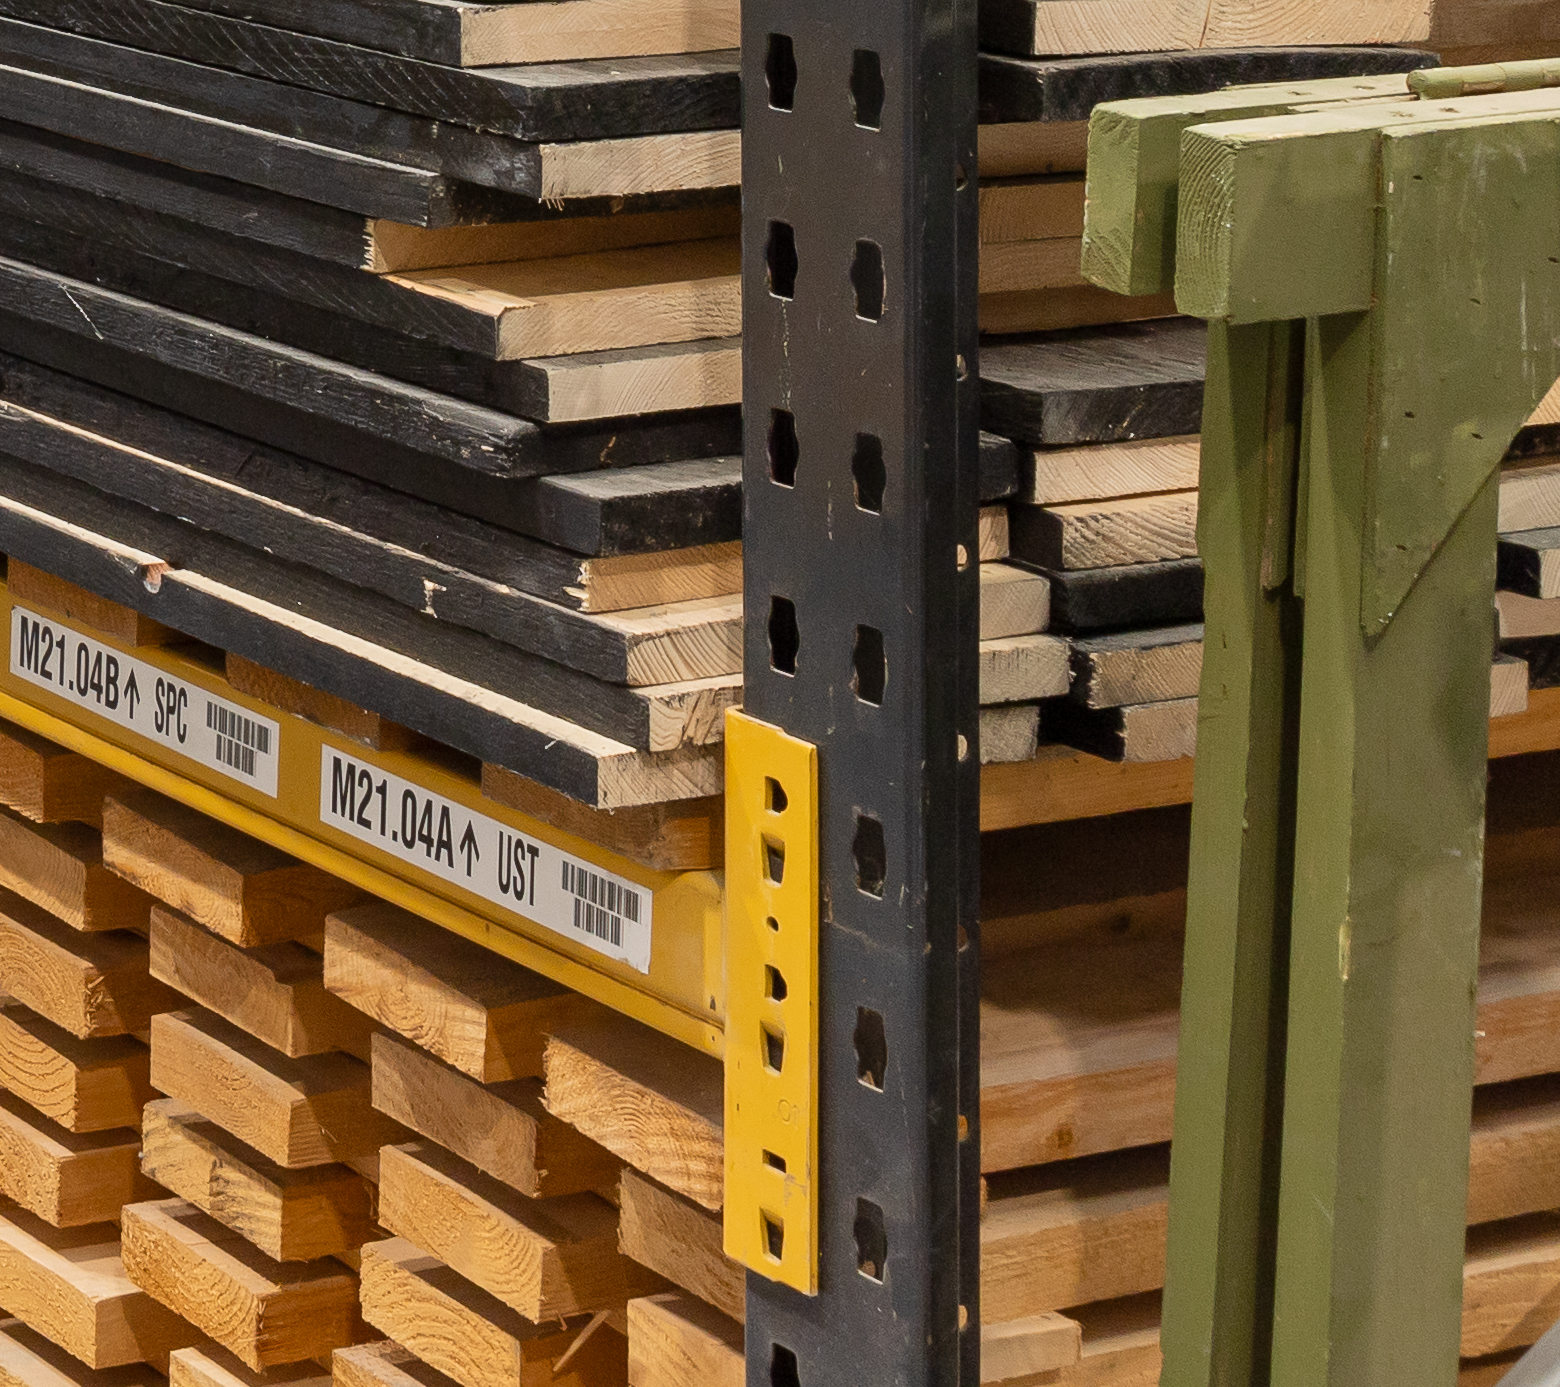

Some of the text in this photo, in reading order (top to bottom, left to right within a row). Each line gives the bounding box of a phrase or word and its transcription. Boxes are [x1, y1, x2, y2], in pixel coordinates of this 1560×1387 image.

[18, 622, 189, 746] M21.04B SPC
[330, 756, 541, 908] M21.04A UST
